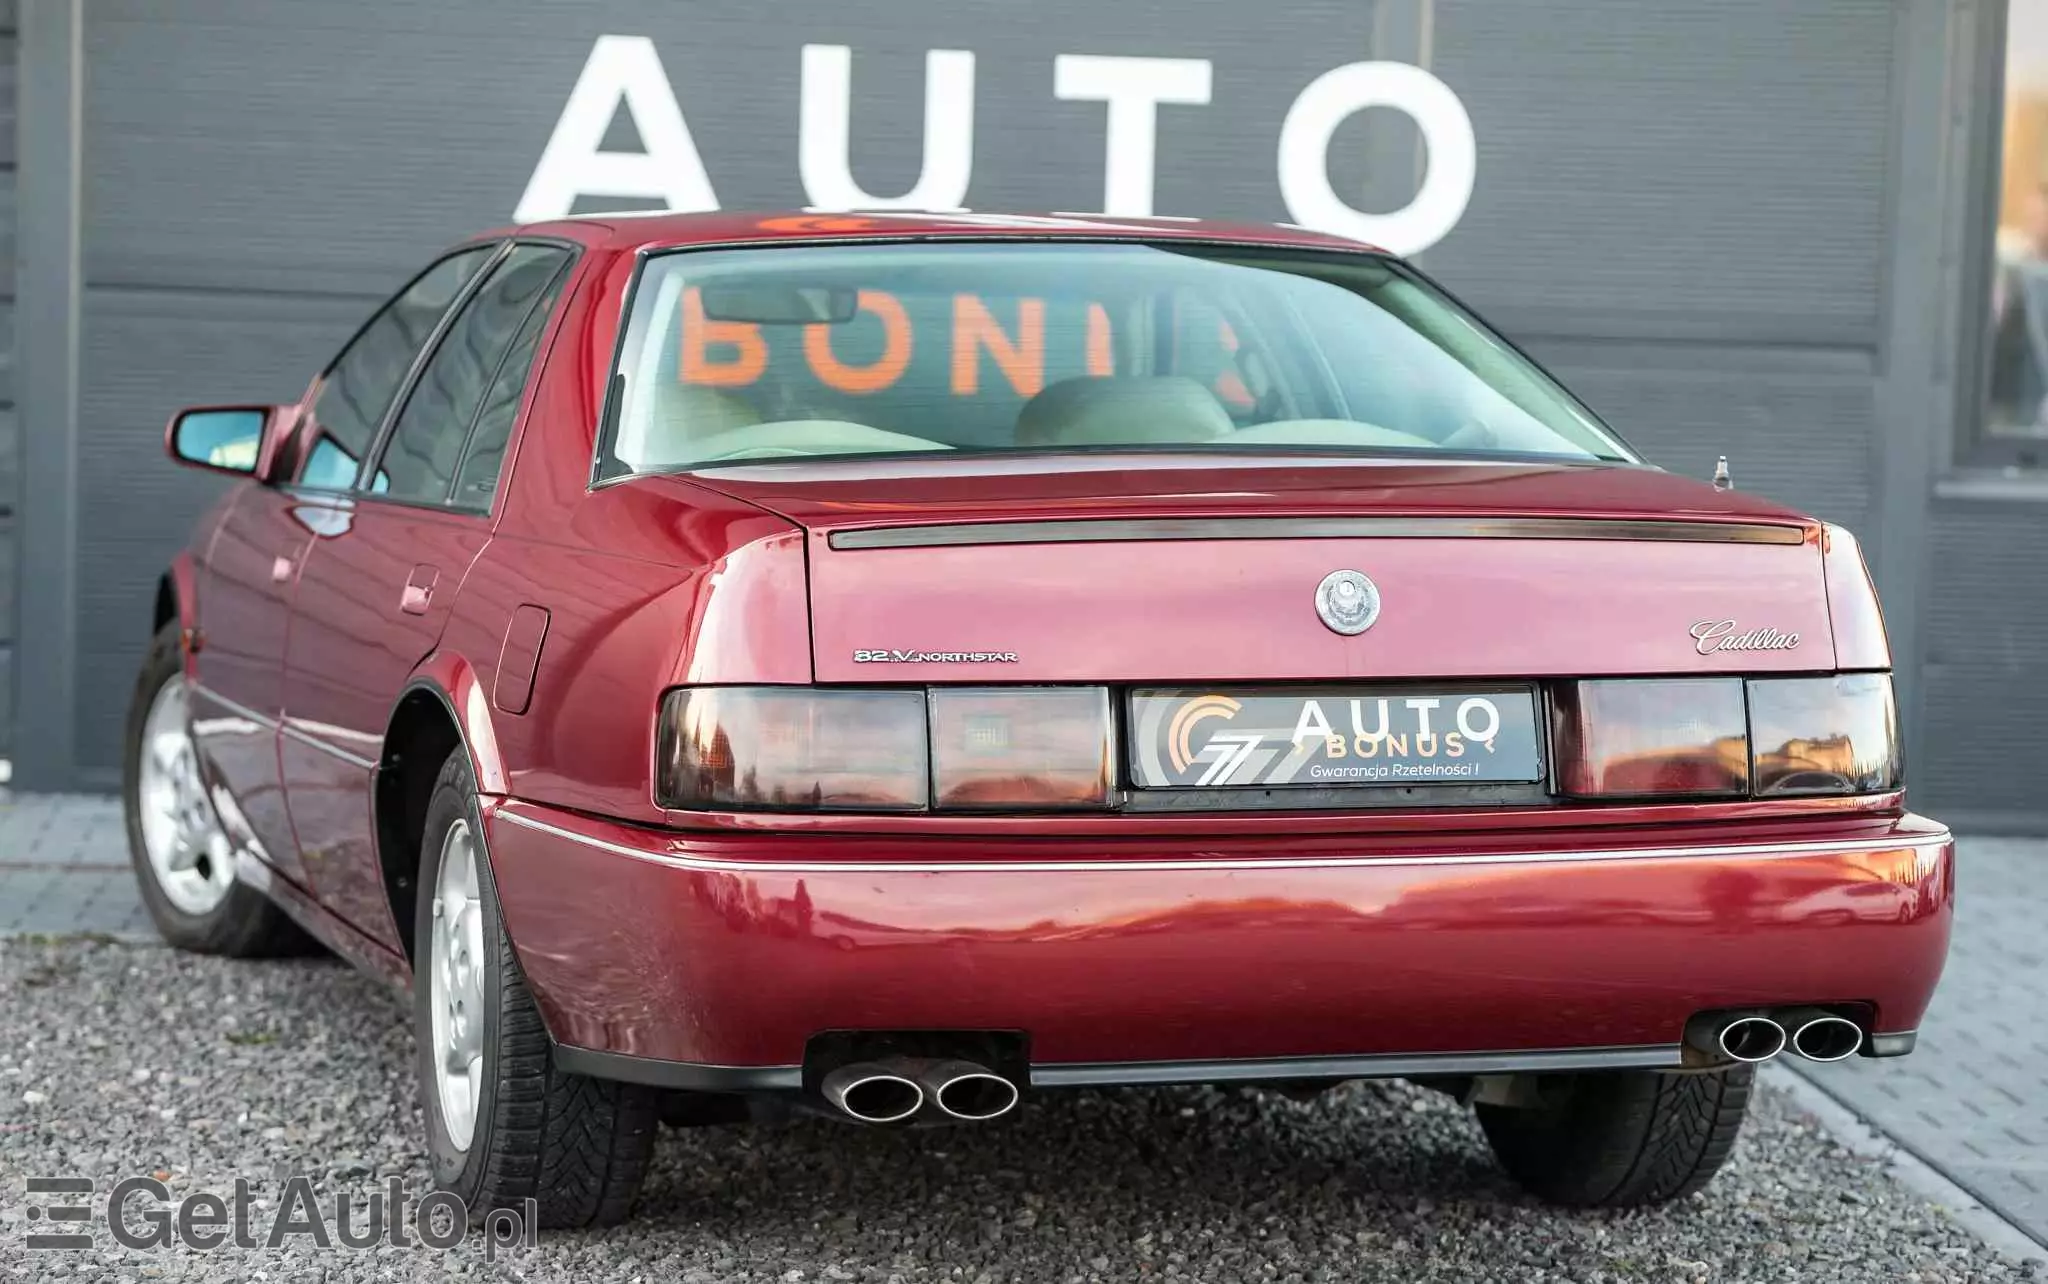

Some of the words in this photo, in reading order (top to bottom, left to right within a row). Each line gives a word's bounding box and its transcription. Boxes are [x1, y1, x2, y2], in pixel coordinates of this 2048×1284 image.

[512, 34, 1477, 259] AUTO
[1689, 619, 1800, 655] Cadillac
[918, 652, 1018, 663] NORTHSTAR
[1291, 697, 1500, 743] AUTO
[1325, 732, 1466, 759] BONUS
[1310, 765, 1389, 779] Gwarancja
[1392, 763, 1472, 777] Rzetelności
